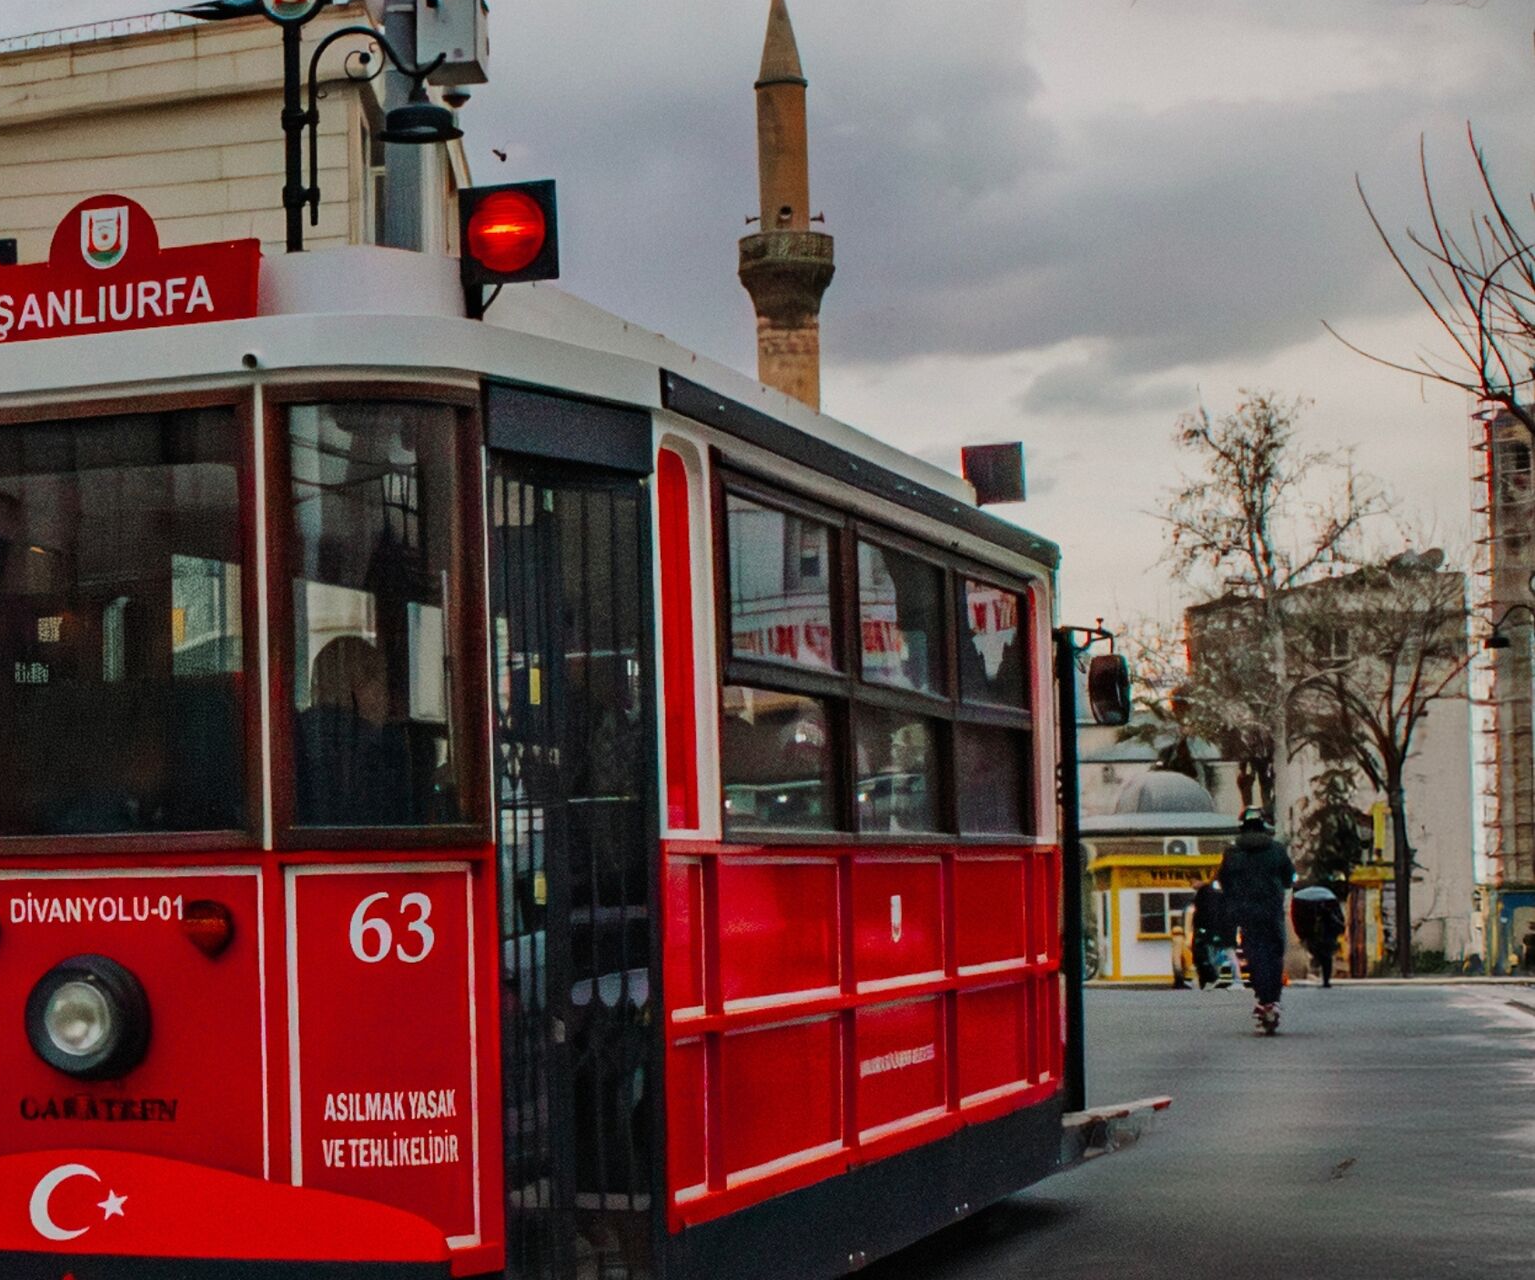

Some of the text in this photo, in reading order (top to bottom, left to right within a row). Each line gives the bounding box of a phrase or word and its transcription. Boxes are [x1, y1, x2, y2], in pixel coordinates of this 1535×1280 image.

[10, 891, 184, 924] DİVANYOLU-01
[349, 891, 435, 963] 63
[324, 1089, 457, 1122] ASILMAK YASAK
[322, 1129, 460, 1168] VE TEHLİKELİDİR
